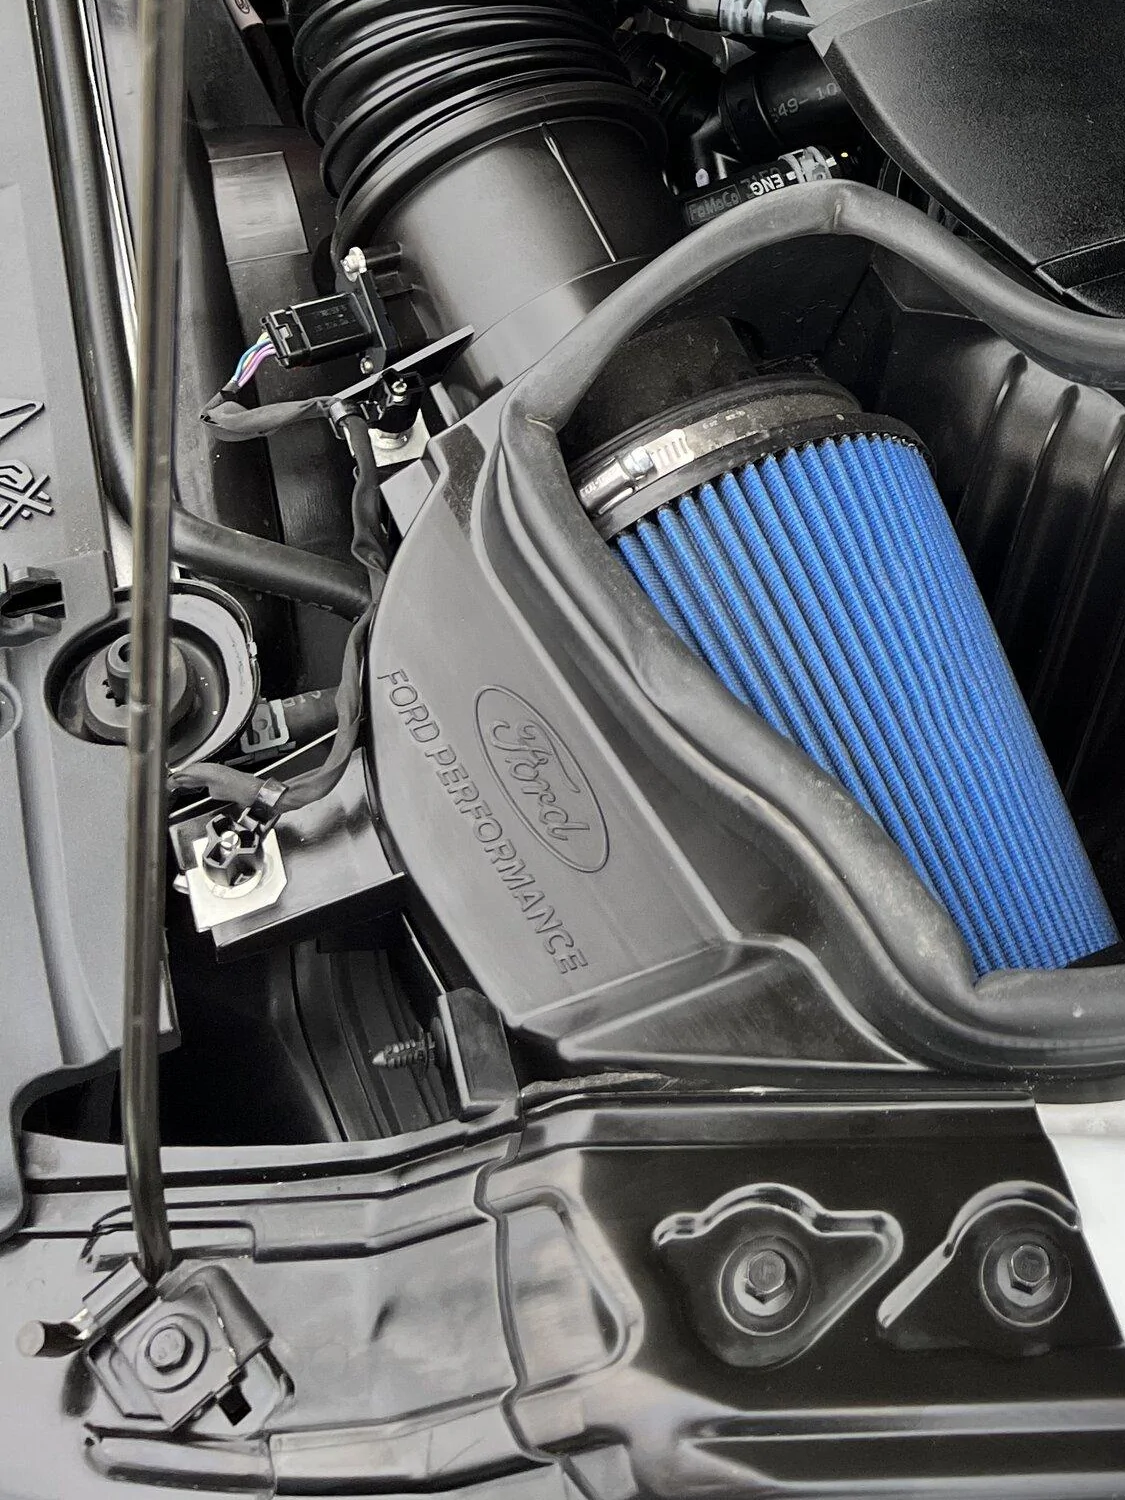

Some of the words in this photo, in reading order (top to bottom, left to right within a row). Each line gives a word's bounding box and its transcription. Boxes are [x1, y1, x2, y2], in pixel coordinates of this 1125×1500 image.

[750, 173, 785, 197] ENG
[376, 668, 441, 744] FORD
[424, 743, 590, 975] PERFORMANCE
[487, 718, 592, 842] Ford
